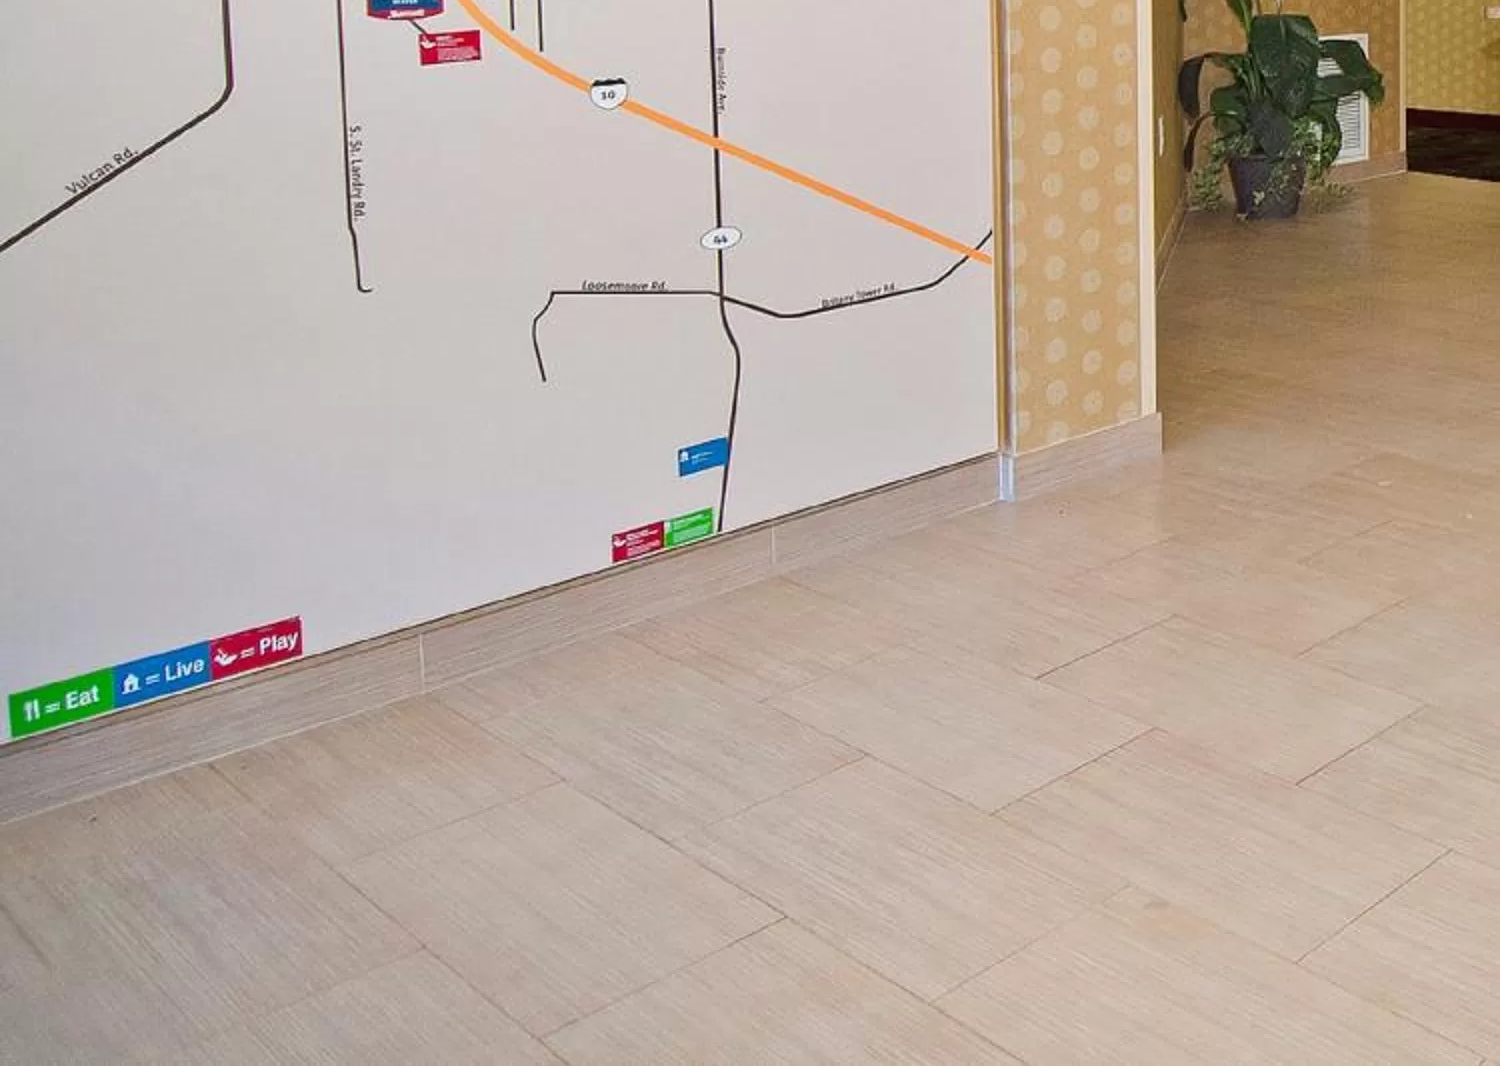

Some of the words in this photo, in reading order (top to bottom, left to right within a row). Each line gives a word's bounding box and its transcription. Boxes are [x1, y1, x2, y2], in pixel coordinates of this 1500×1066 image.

[601, 89, 616, 101] 10
[64, 161, 114, 196] Vulcan
[113, 147, 139, 165] Rd.
[350, 159, 366, 199] Landry
[353, 201, 367, 222] Rd.
[259, 630, 300, 657] Play
[165, 658, 206, 683] Live
[65, 684, 100, 711] Eat
